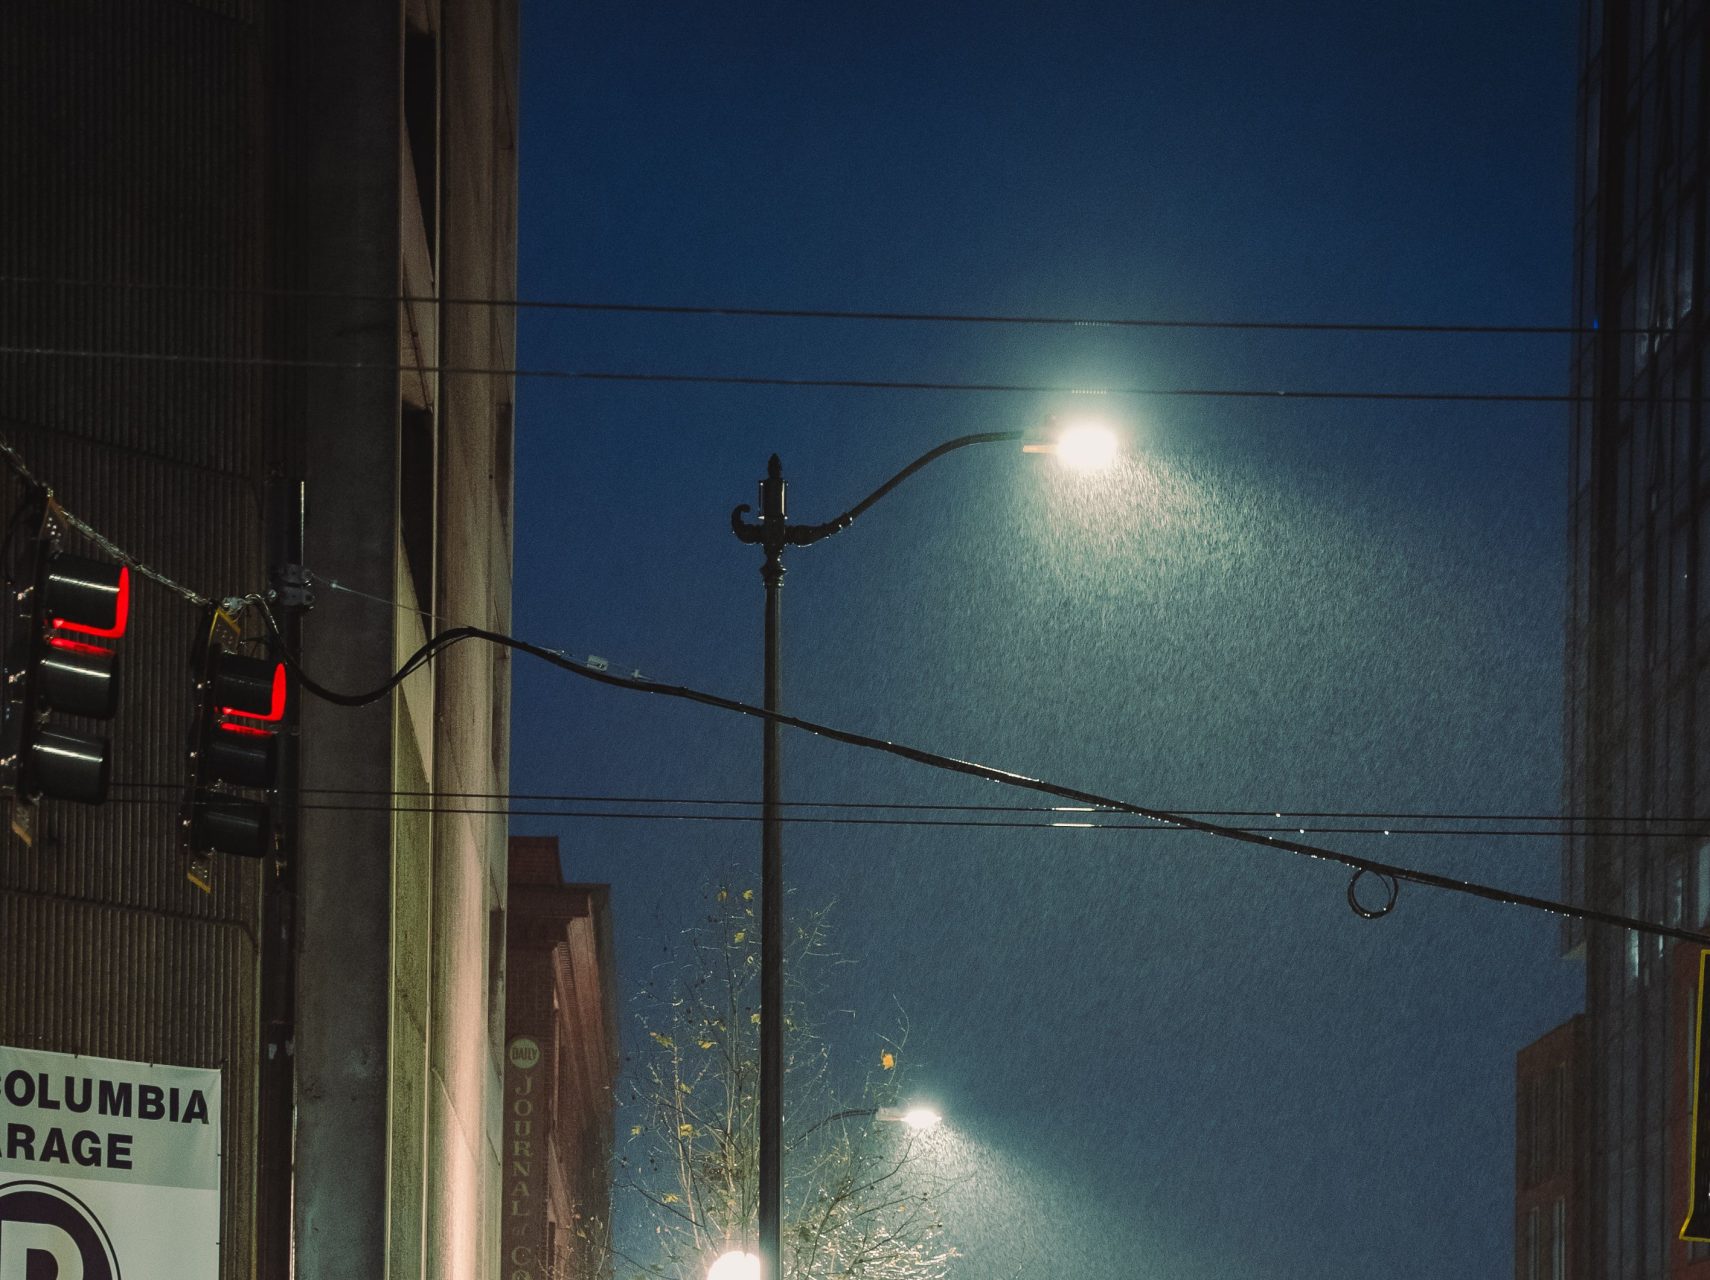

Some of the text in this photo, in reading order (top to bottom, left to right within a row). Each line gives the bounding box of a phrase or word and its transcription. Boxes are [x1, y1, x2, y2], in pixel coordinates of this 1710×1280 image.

[0, 1069, 210, 1125] OLUMBIA
[0, 1122, 134, 1170] RAGE
[511, 1075, 533, 1216] JOURNAL
